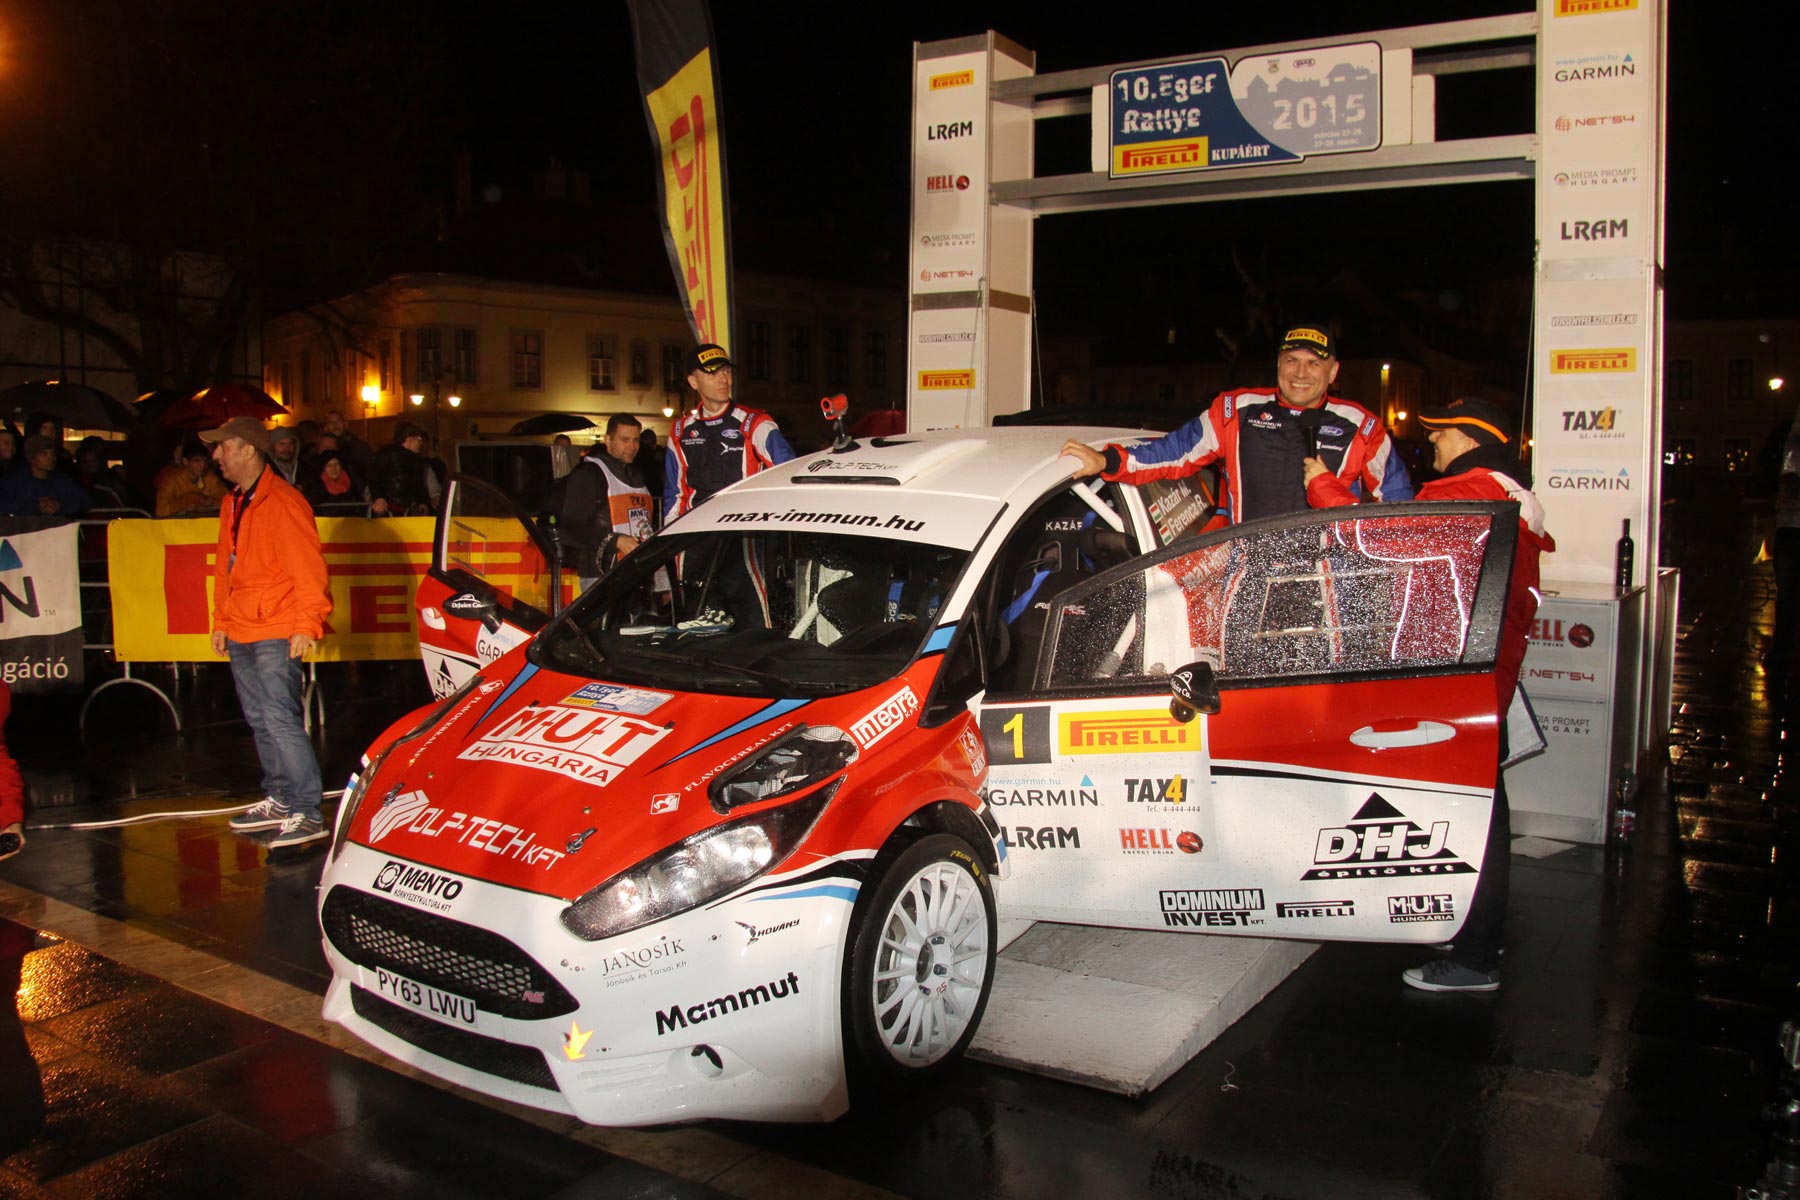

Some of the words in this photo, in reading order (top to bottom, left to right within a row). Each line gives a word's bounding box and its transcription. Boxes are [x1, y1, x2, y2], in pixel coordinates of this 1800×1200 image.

[1555, 64, 1635, 82] GARMIN
[1122, 108, 1201, 134] Rallye
[1273, 94, 1366, 130] 2015
[928, 121, 973, 141] LRAM
[1122, 142, 1200, 168] PIRELLI
[1211, 144, 1271, 161] KUPÁÉRT
[927, 175, 954, 190] HELL
[1570, 169, 1598, 180] MEDIA
[1600, 168, 1637, 178] PROMPT
[1570, 176, 1638, 187] HUNGARY
[1561, 219, 1628, 241] LRAM
[1557, 352, 1629, 370] PIRELLI
[922, 372, 971, 387] PIRELLI
[1548, 476, 1630, 491] GARMIN
[1158, 487, 1180, 515] Kazár
[716, 508, 926, 532] max-immun.hu
[1168, 503, 1200, 537] Ferencz
[1070, 717, 1187, 748] PIRELLI
[1552, 716, 1590, 727] PROMPT
[1002, 713, 1024, 759] 1
[467, 746, 611, 783] HUNGÁRIA
[989, 789, 1098, 807] GARMIN
[1001, 826, 1081, 851] LRAM
[1119, 828, 1173, 849] HELL
[1314, 821, 1450, 865] DHJ
[520, 845, 566, 871] KFT
[1160, 889, 1262, 912] DOMINIUM
[1275, 900, 1355, 918] PIRELLI
[1163, 911, 1250, 926] INVEST
[378, 970, 423, 1007] PY63
[428, 986, 476, 1025] LWU
[655, 971, 801, 1036] Mammut
